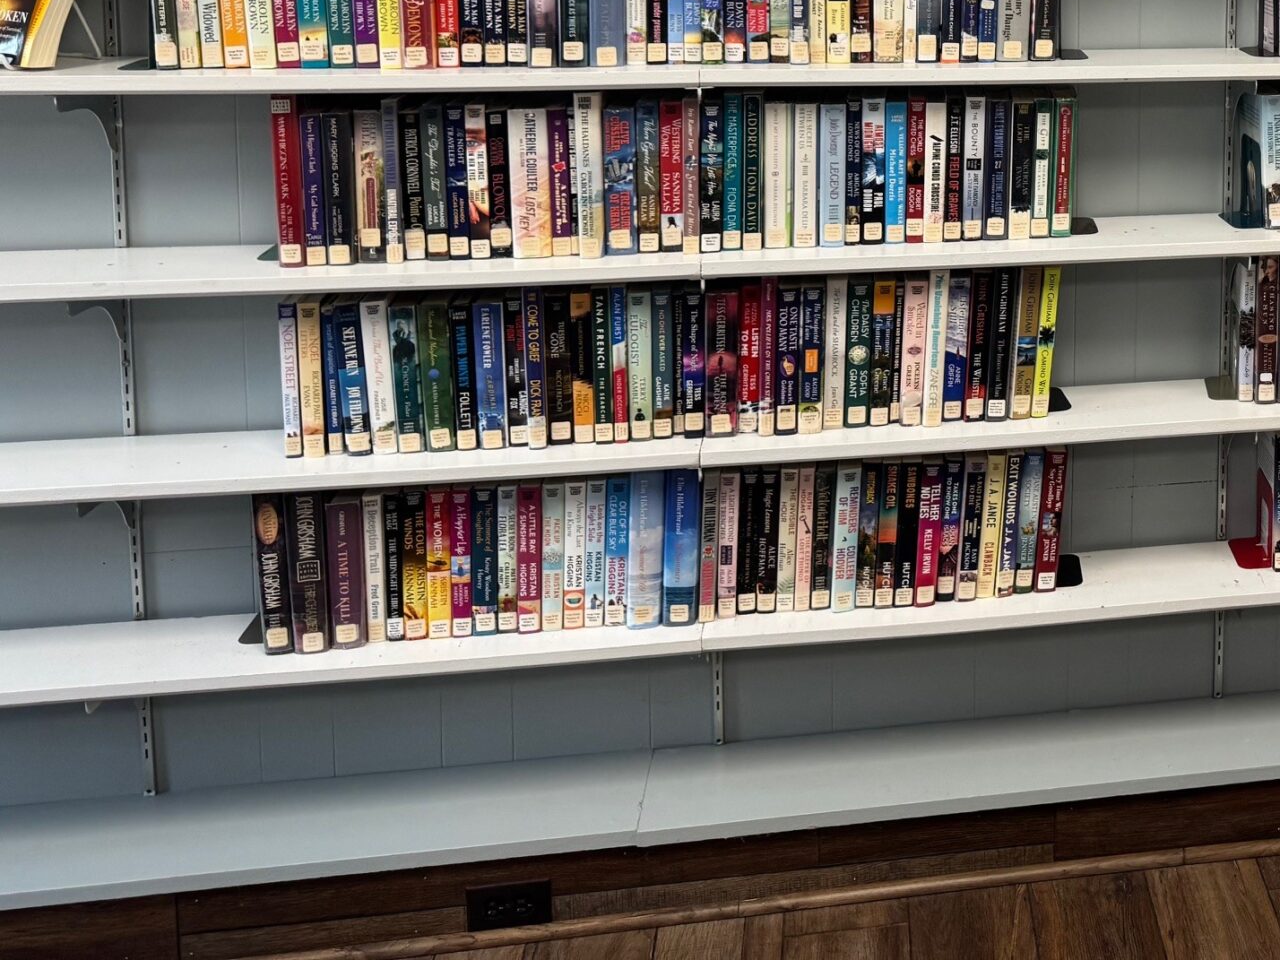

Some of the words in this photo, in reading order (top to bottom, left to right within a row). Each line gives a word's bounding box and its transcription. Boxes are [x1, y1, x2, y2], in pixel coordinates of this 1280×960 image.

[203, 1, 219, 44] Widowed
[524, 113, 537, 154] CATHERINE
[660, 125, 670, 158] WOMEN
[671, 119, 681, 164] WESTERING
[526, 157, 538, 192] COULTER
[661, 173, 671, 212] DALLAS
[829, 162, 840, 200] LEGEND
[595, 296, 604, 324] TANA
[850, 299, 860, 342] CHILDREN
[596, 329, 606, 369] FRENCH
[751, 327, 759, 358] LISTEN
[849, 369, 857, 398] GRANT
[860, 370, 868, 395] SOFIA
[460, 392, 471, 429] FOLLETT
[848, 486, 859, 534] REMINDERS
[931, 484, 941, 503] TELL
[1007, 480, 1017, 525] WOUNDS
[930, 505, 939, 521] HER
[987, 500, 998, 528] JANCE
[404, 518, 413, 550] WINDS
[433, 523, 443, 559] WOMEN
[519, 516, 527, 553] SUNSHINE
[983, 542, 994, 577] CLAWBACK
[404, 564, 415, 606] HANNAH
